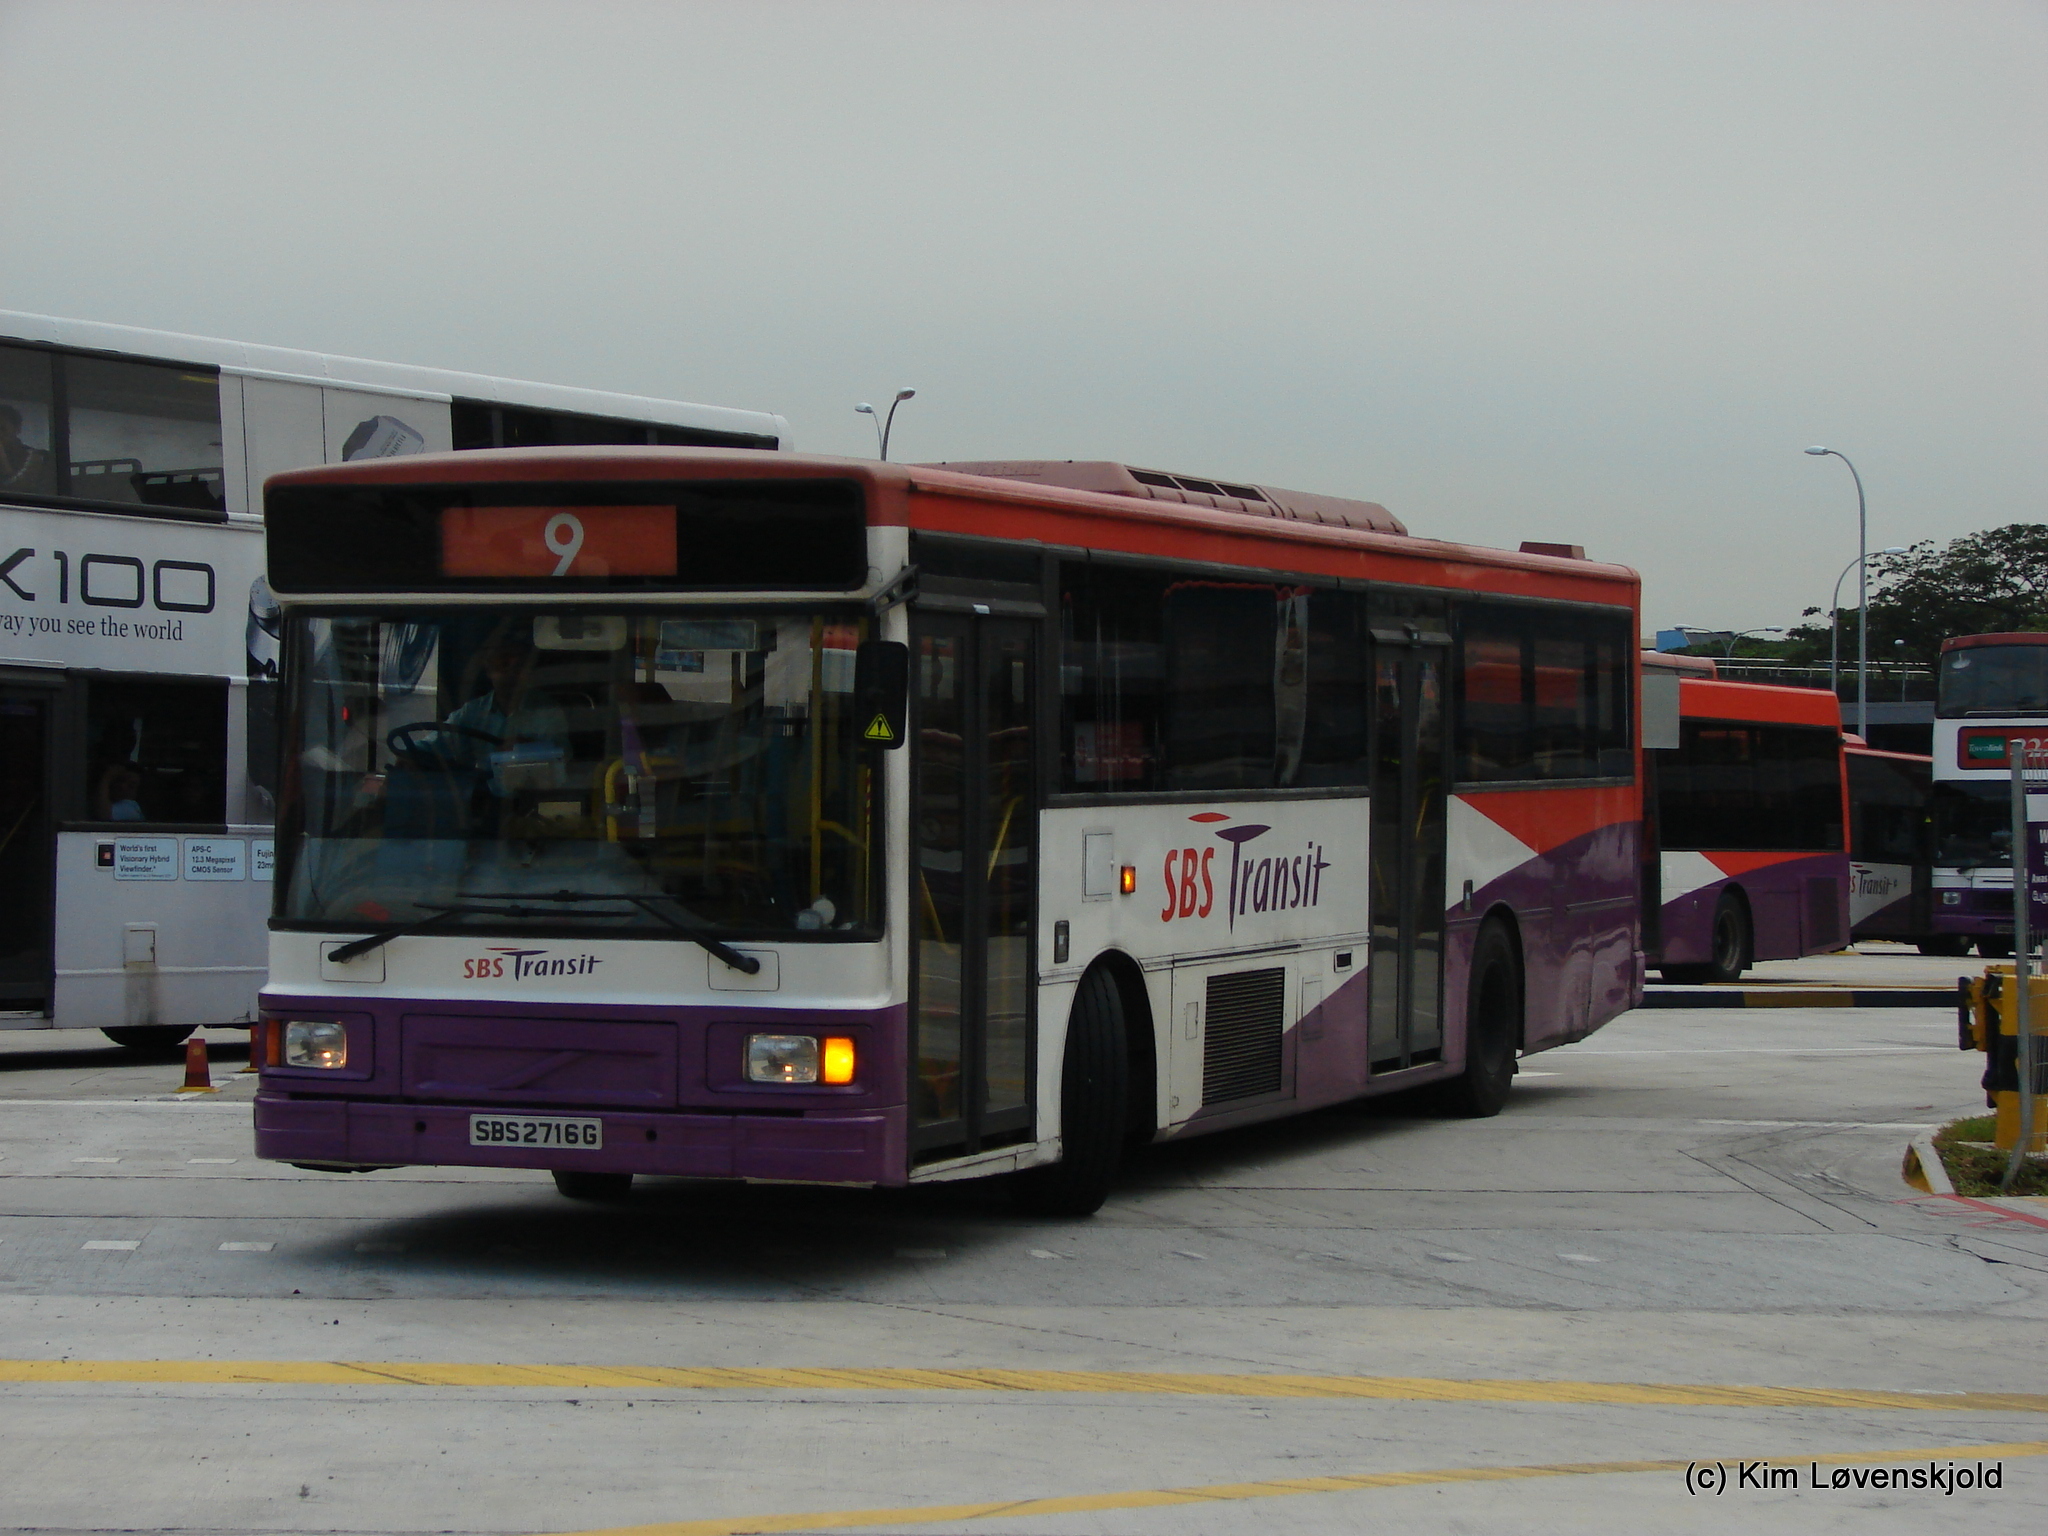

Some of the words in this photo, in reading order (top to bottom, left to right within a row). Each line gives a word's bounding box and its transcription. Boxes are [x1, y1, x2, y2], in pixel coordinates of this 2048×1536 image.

[544, 512, 585, 577] 9
[0, 614, 25, 637] ay
[29, 617, 62, 637] you
[66, 618, 96, 636] see
[100, 615, 129, 638] the
[133, 619, 183, 641] world
[191, 845, 212, 854] APS-C
[191, 856, 206, 864] 12.3
[205, 856, 237, 865] Megapixel
[191, 866, 211, 874] CMOS
[212, 866, 234, 874] Sensor
[1161, 846, 1215, 923] SBS
[1214, 824, 1332, 935] Transit
[463, 957, 504, 979] SBS
[501, 949, 604, 982] Transit
